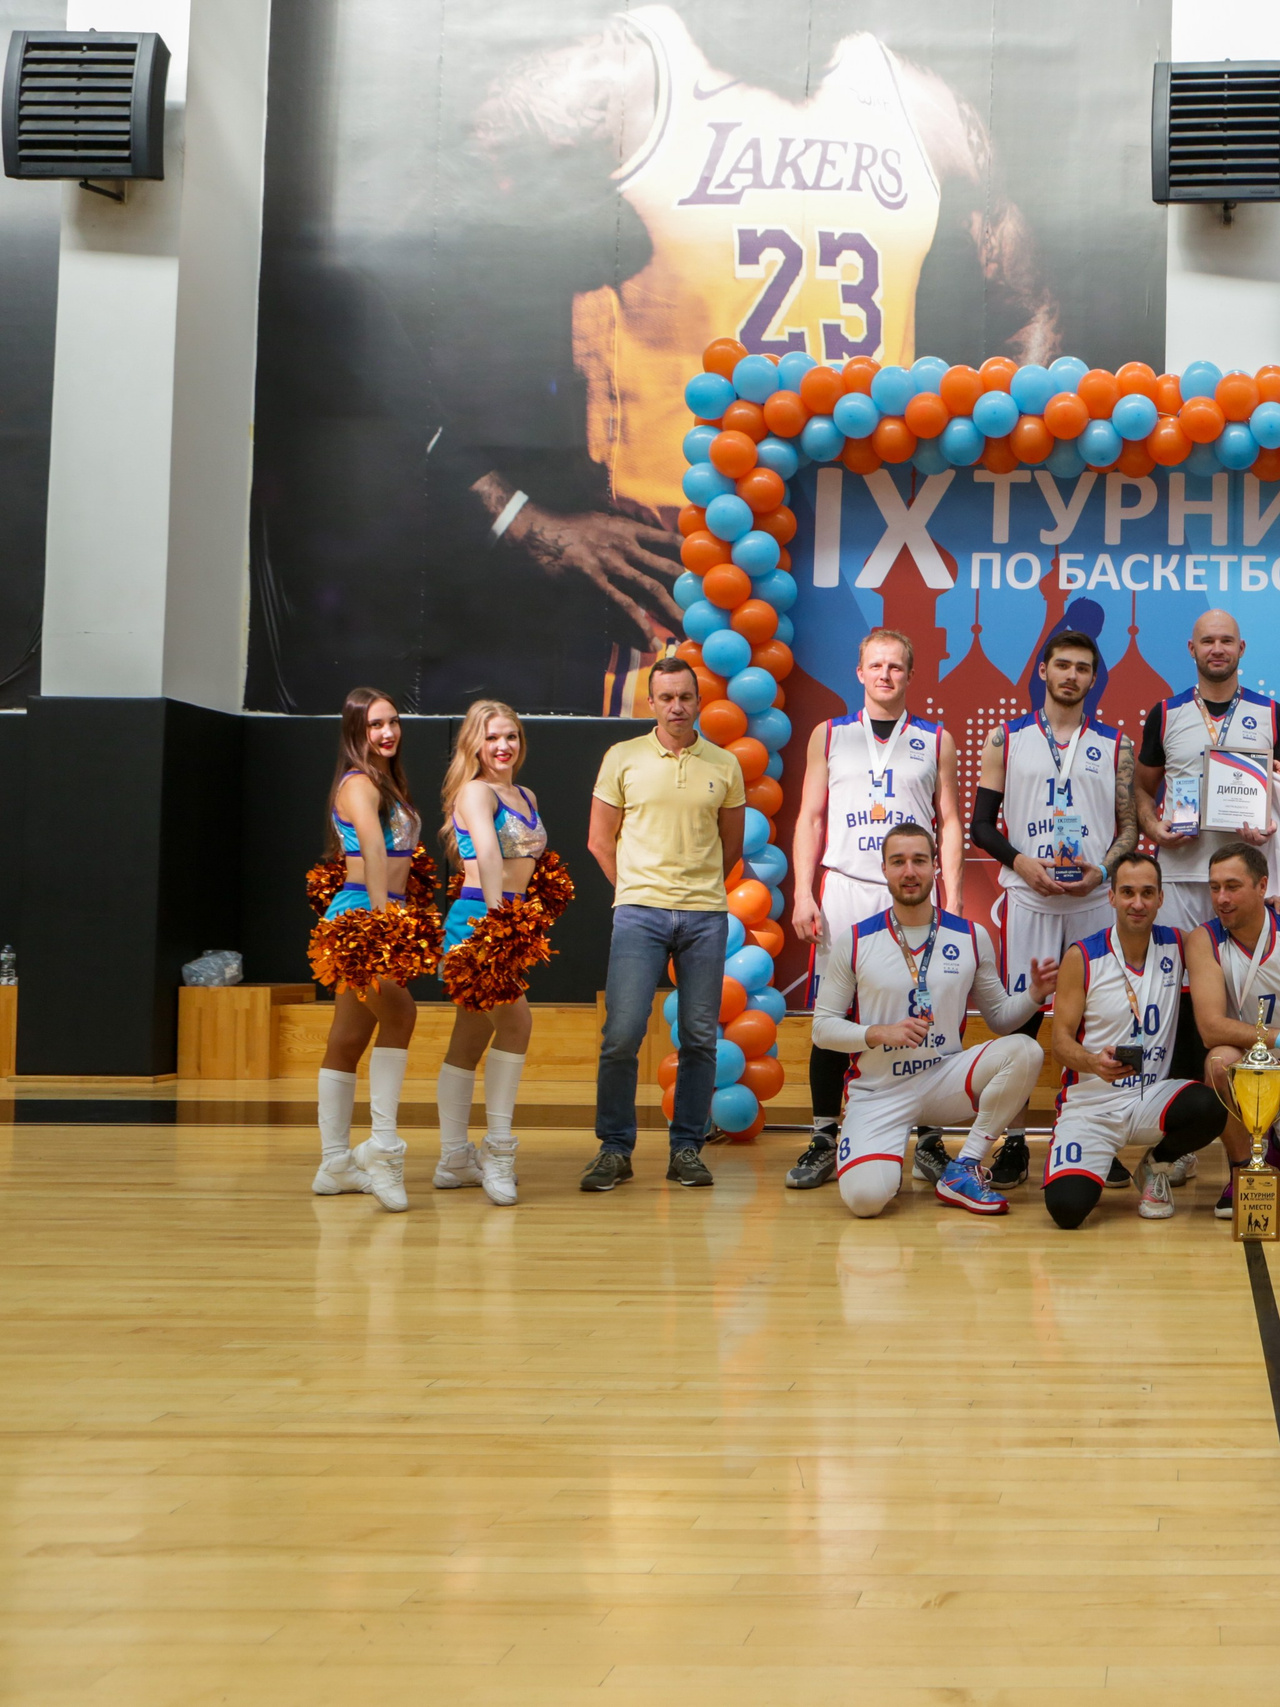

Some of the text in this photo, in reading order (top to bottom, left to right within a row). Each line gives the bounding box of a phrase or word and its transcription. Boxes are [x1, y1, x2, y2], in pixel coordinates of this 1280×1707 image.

[678, 121, 908, 210] LAKERS
[736, 226, 883, 364] 23
[813, 467, 955, 589] IX
[971, 552, 1042, 589] ПО
[1217, 785, 1258, 796] ДИПЛОМ
[846, 810, 917, 828] ВНИЭФ
[858, 836, 885, 851] САР
[1258, 994, 1276, 1024] 7
[839, 1137, 851, 1162] 8
[1053, 1142, 1082, 1168] 10
[1240, 1193, 1249, 1201] IX
